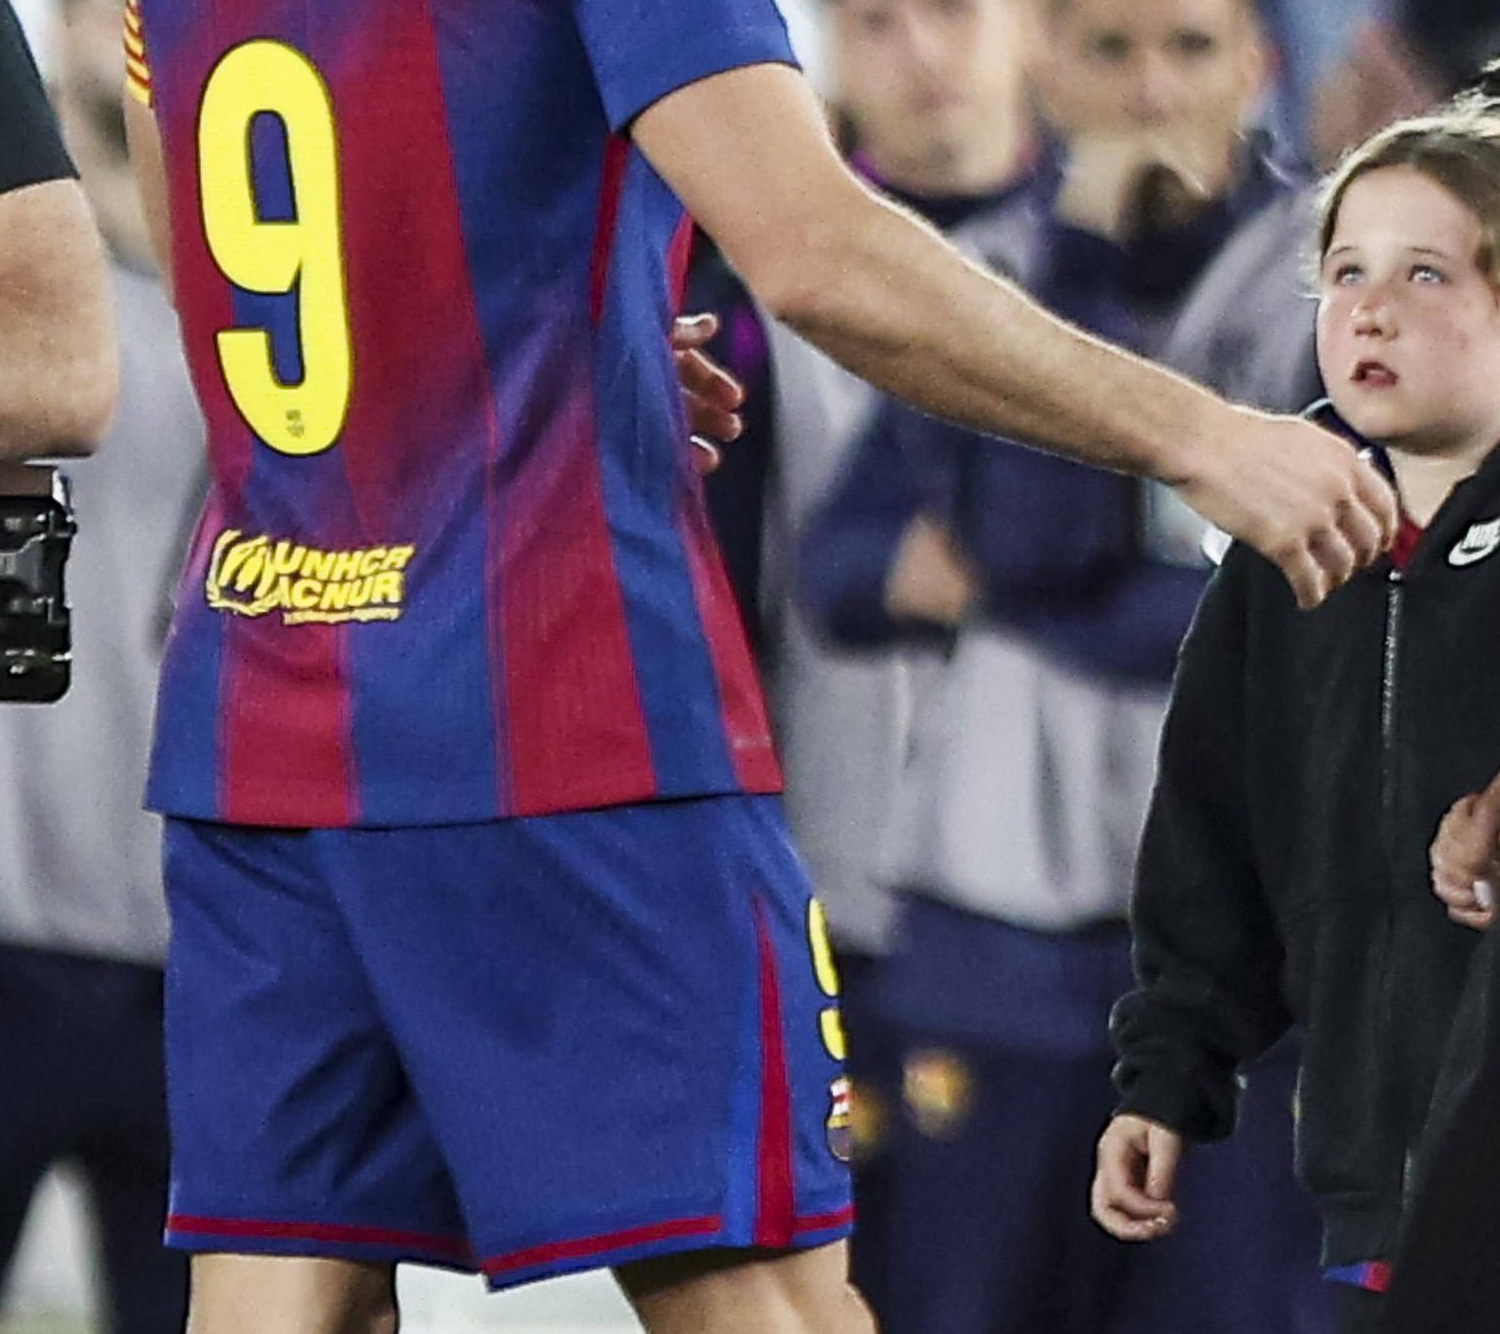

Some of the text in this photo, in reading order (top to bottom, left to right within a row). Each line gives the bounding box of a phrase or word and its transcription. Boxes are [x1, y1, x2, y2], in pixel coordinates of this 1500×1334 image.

[198, 38, 354, 454] 9
[274, 540, 415, 581] UNHCR
[277, 570, 405, 609] ACNUR
